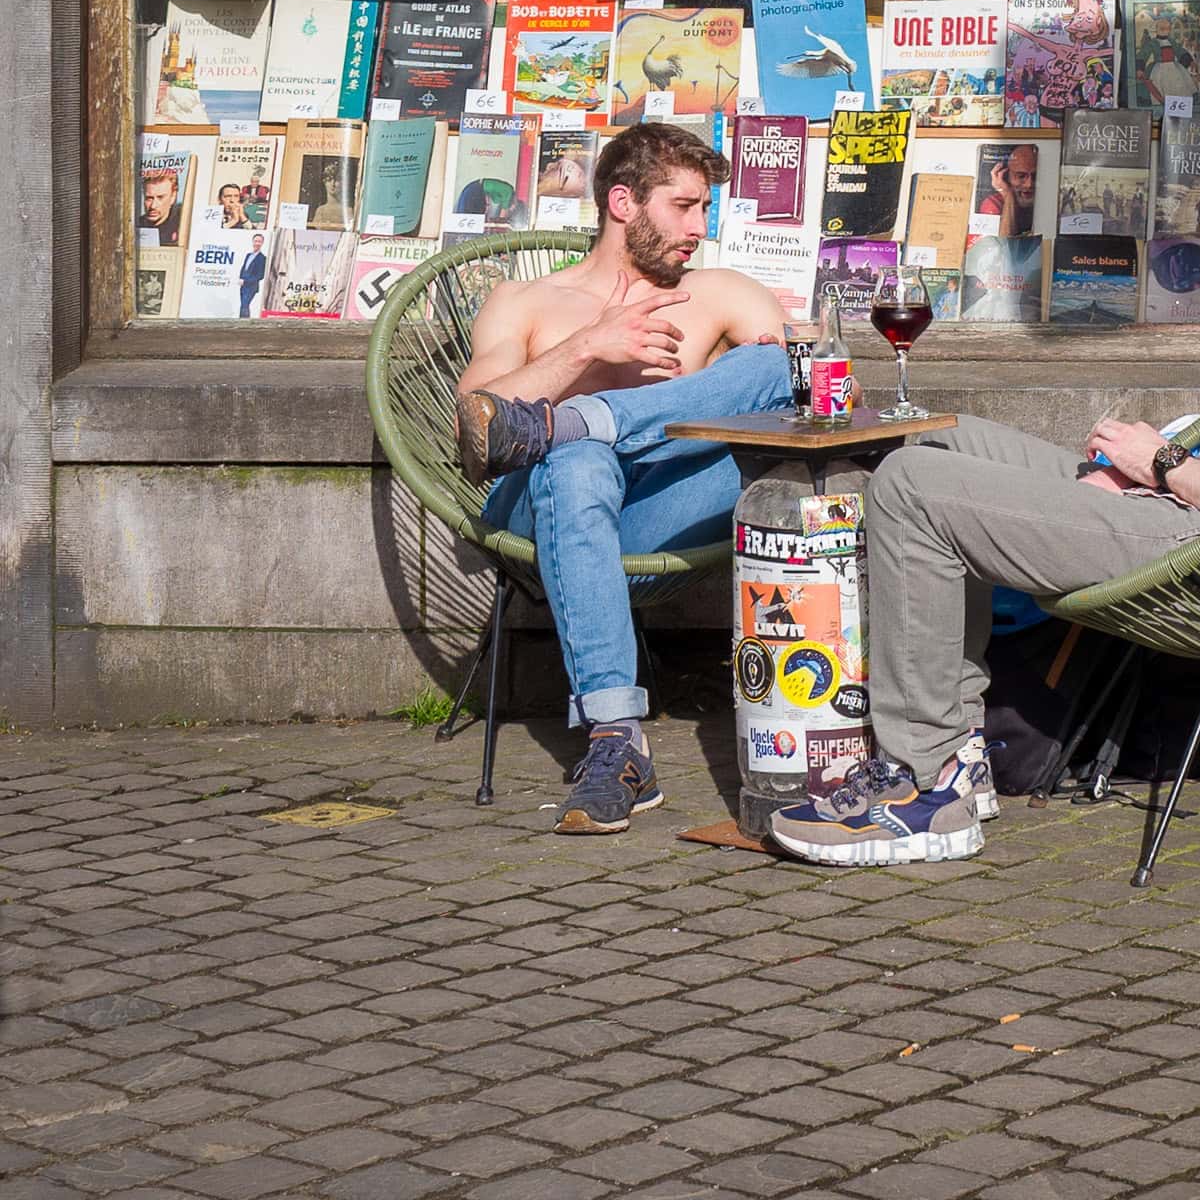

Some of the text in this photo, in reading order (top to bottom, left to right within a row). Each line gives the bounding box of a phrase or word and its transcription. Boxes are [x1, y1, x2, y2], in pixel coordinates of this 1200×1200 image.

[411, 3, 471, 13] GUIDE ATLAS
[760, 0, 844, 18] photographique
[1014, 0, 1026, 9] ON
[511, 5, 538, 18] BOB
[548, 5, 610, 18] BOBETTE
[539, 18, 569, 28] CERCLE
[571, 18, 591, 28] D'OR
[691, 18, 734, 28] JACQUES
[435, 25, 482, 40] FRANCE
[683, 28, 733, 38] DUPONT
[893, 15, 998, 47] UNE BIBLE
[199, 66, 258, 77] FABIOLA
[268, 87, 317, 96] CHINOISE
[475, 93, 497, 108] 6€
[740, 100, 757, 113] 5€
[463, 117, 493, 130] SOPHIE
[494, 118, 536, 132] MARCEAU
[1077, 123, 1140, 139] GAGNE
[763, 125, 782, 139] LES
[828, 135, 908, 164] SPEER
[1170, 146, 1185, 160] La
[140, 156, 186, 169] HALLYDAY
[218, 154, 229, 162] de
[743, 152, 798, 169] VIVANTS
[826, 182, 867, 193] SPANDAU
[743, 230, 800, 247] Principes
[384, 246, 429, 260] HITLER
[728, 241, 743, 252] de
[194, 250, 235, 265] BERN
[1072, 255, 1129, 266] Sales blancs
[286, 281, 327, 293] Agates
[750, 728, 775, 744] Uncle
